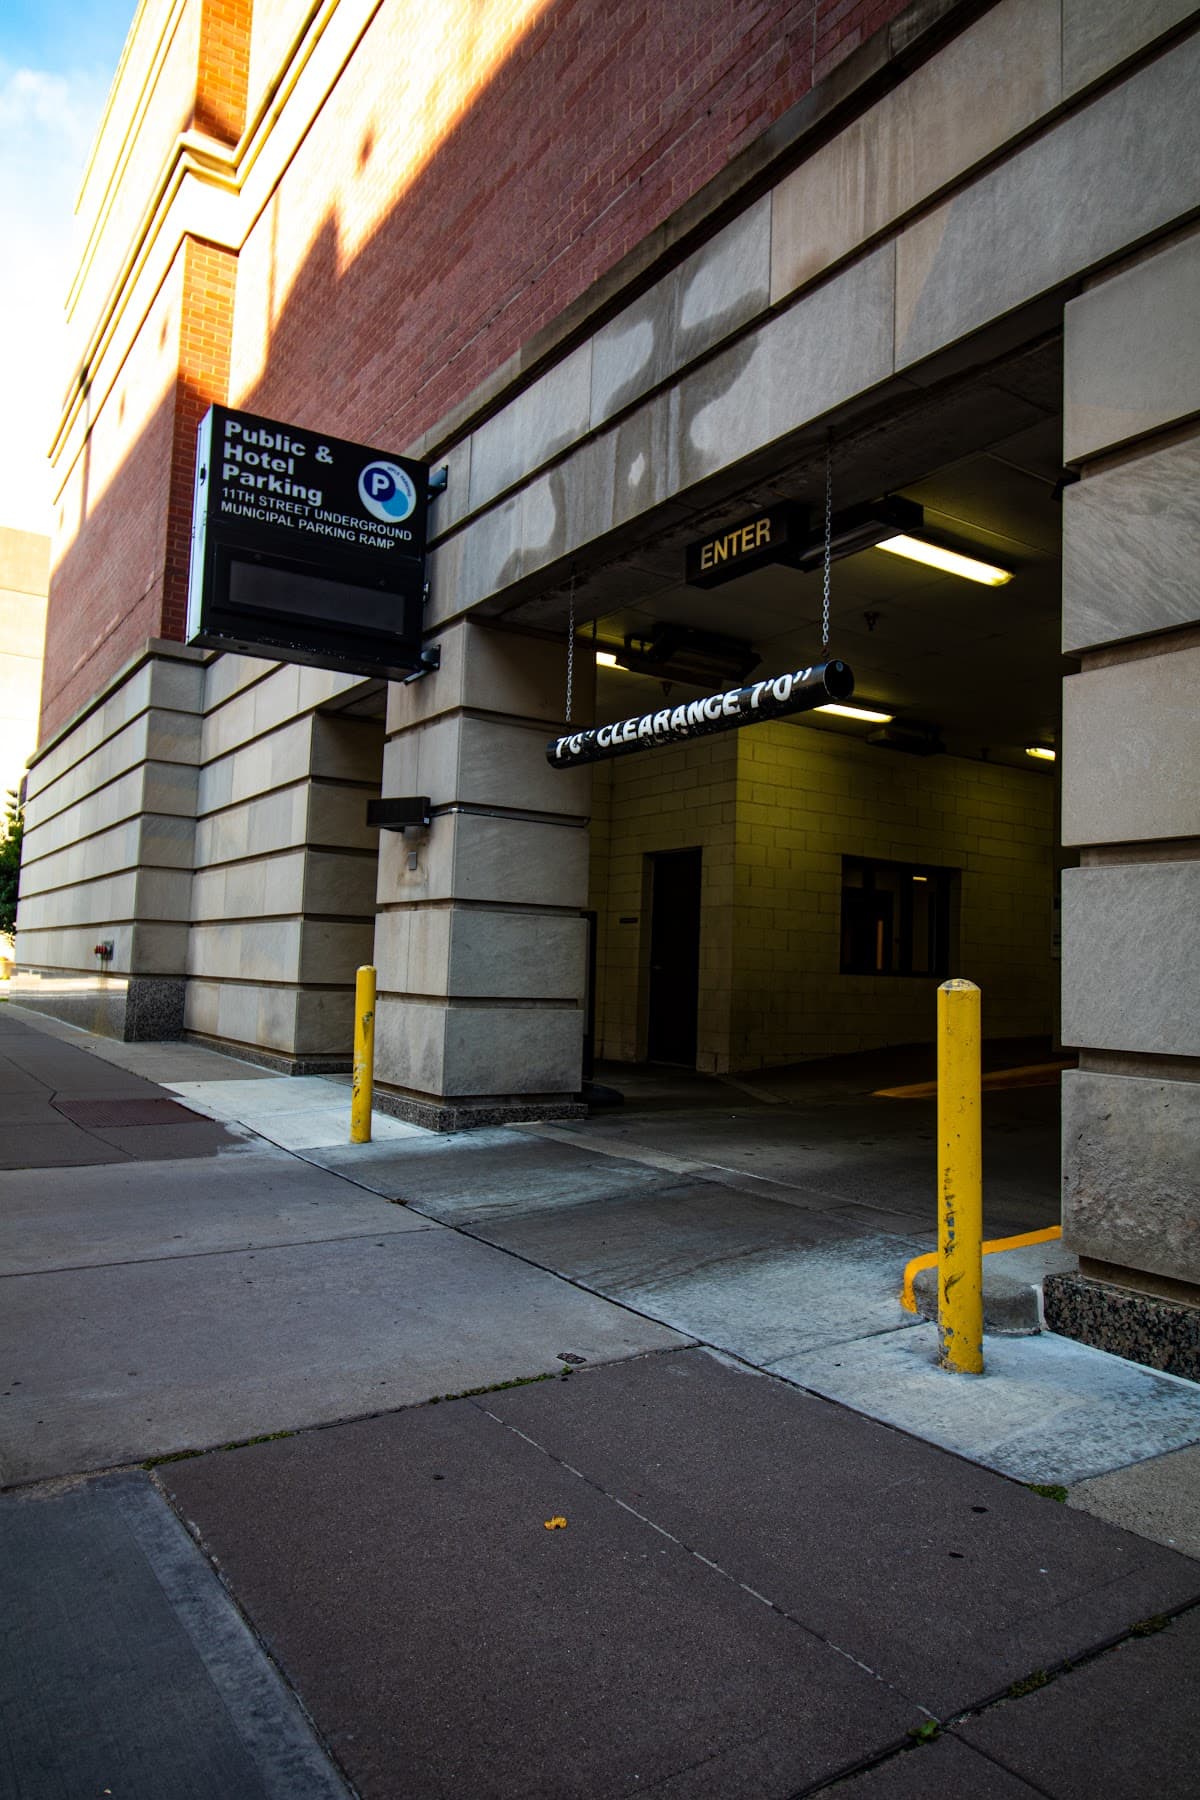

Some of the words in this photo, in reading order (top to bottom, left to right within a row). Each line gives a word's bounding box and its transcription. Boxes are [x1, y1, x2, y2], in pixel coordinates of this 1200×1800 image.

[223, 441, 295, 475] Hotel
[224, 419, 306, 457] Public
[315, 445, 334, 465] &
[222, 463, 323, 507] Parking
[371, 472, 390, 496] P
[221, 501, 295, 528] MUNICIPAL
[298, 519, 356, 541] PARKING
[359, 533, 395, 550] RAMP
[222, 487, 255, 504] 11TH
[259, 495, 311, 517] STREET
[314, 508, 412, 541] UNDERGROUND
[700, 517, 771, 570] ENTER
[596, 687, 742, 748] CLEARANCE
